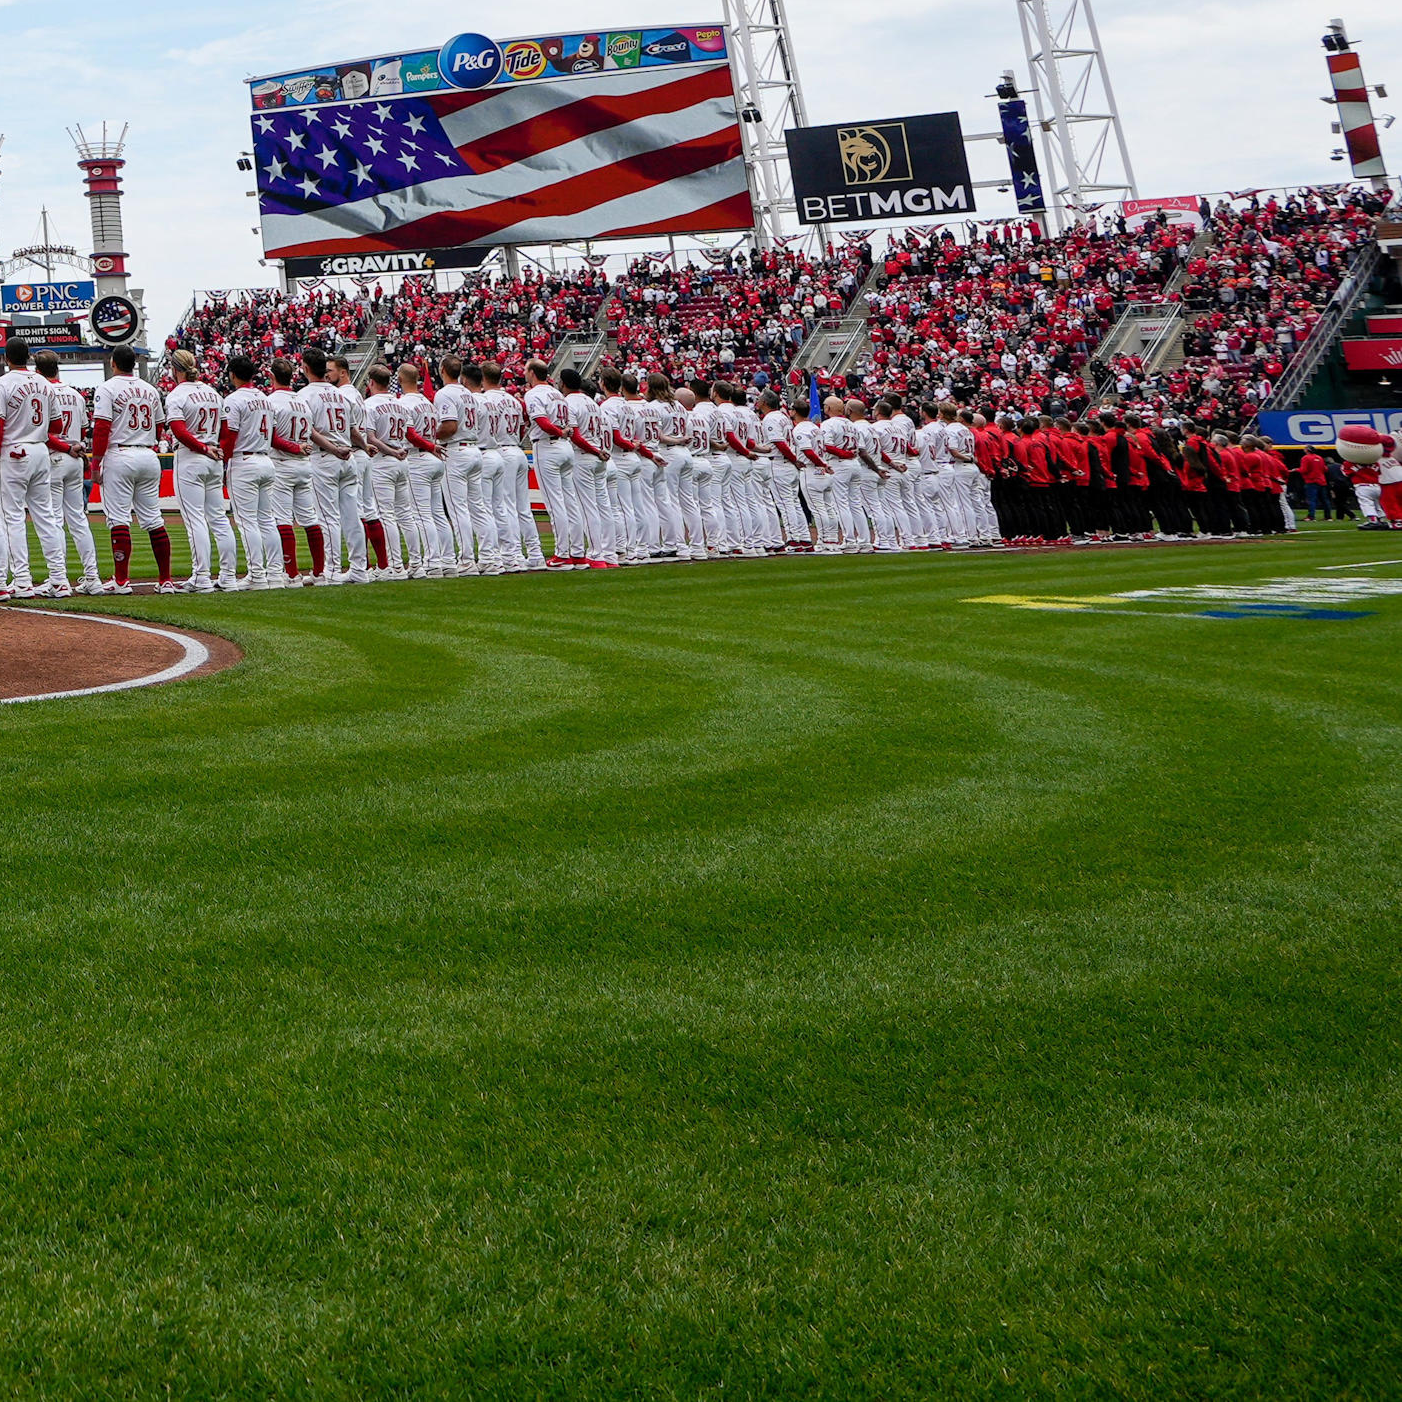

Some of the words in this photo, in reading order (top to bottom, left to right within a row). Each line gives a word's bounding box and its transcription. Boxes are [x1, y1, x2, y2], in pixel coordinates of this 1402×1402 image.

[696, 29, 721, 39] Pepto
[607, 38, 639, 57] Bounty
[451, 49, 495, 73] P&G
[505, 50, 541, 75] Tide
[406, 70, 439, 83] Pampers
[281, 81, 315, 96] Swiffer
[802, 184, 968, 221] BETMGM
[332, 253, 426, 274] GRAVITY
[34, 284, 78, 301] PNC
[5, 302, 44, 311] POWER
[48, 299, 91, 310] STACKS
[15, 328, 31, 336] RED
[31, 328, 49, 336] HITS
[49, 327, 71, 336] SIGN,
[25, 336, 46, 344] WINS
[46, 335, 79, 343] TUNDRA
[31, 398, 43, 426] 3
[128, 403, 153, 432] 33
[198, 407, 219, 435] 27
[326, 407, 346, 434] 15
[61, 410, 72, 436] 7
[259, 414, 269, 441] 4
[290, 415, 308, 442] 12
[389, 416, 405, 440] 26
[506, 414, 519, 435] 37
[644, 421, 659, 442] 55
[672, 416, 686, 437] 58
[692, 430, 707, 450] 59
